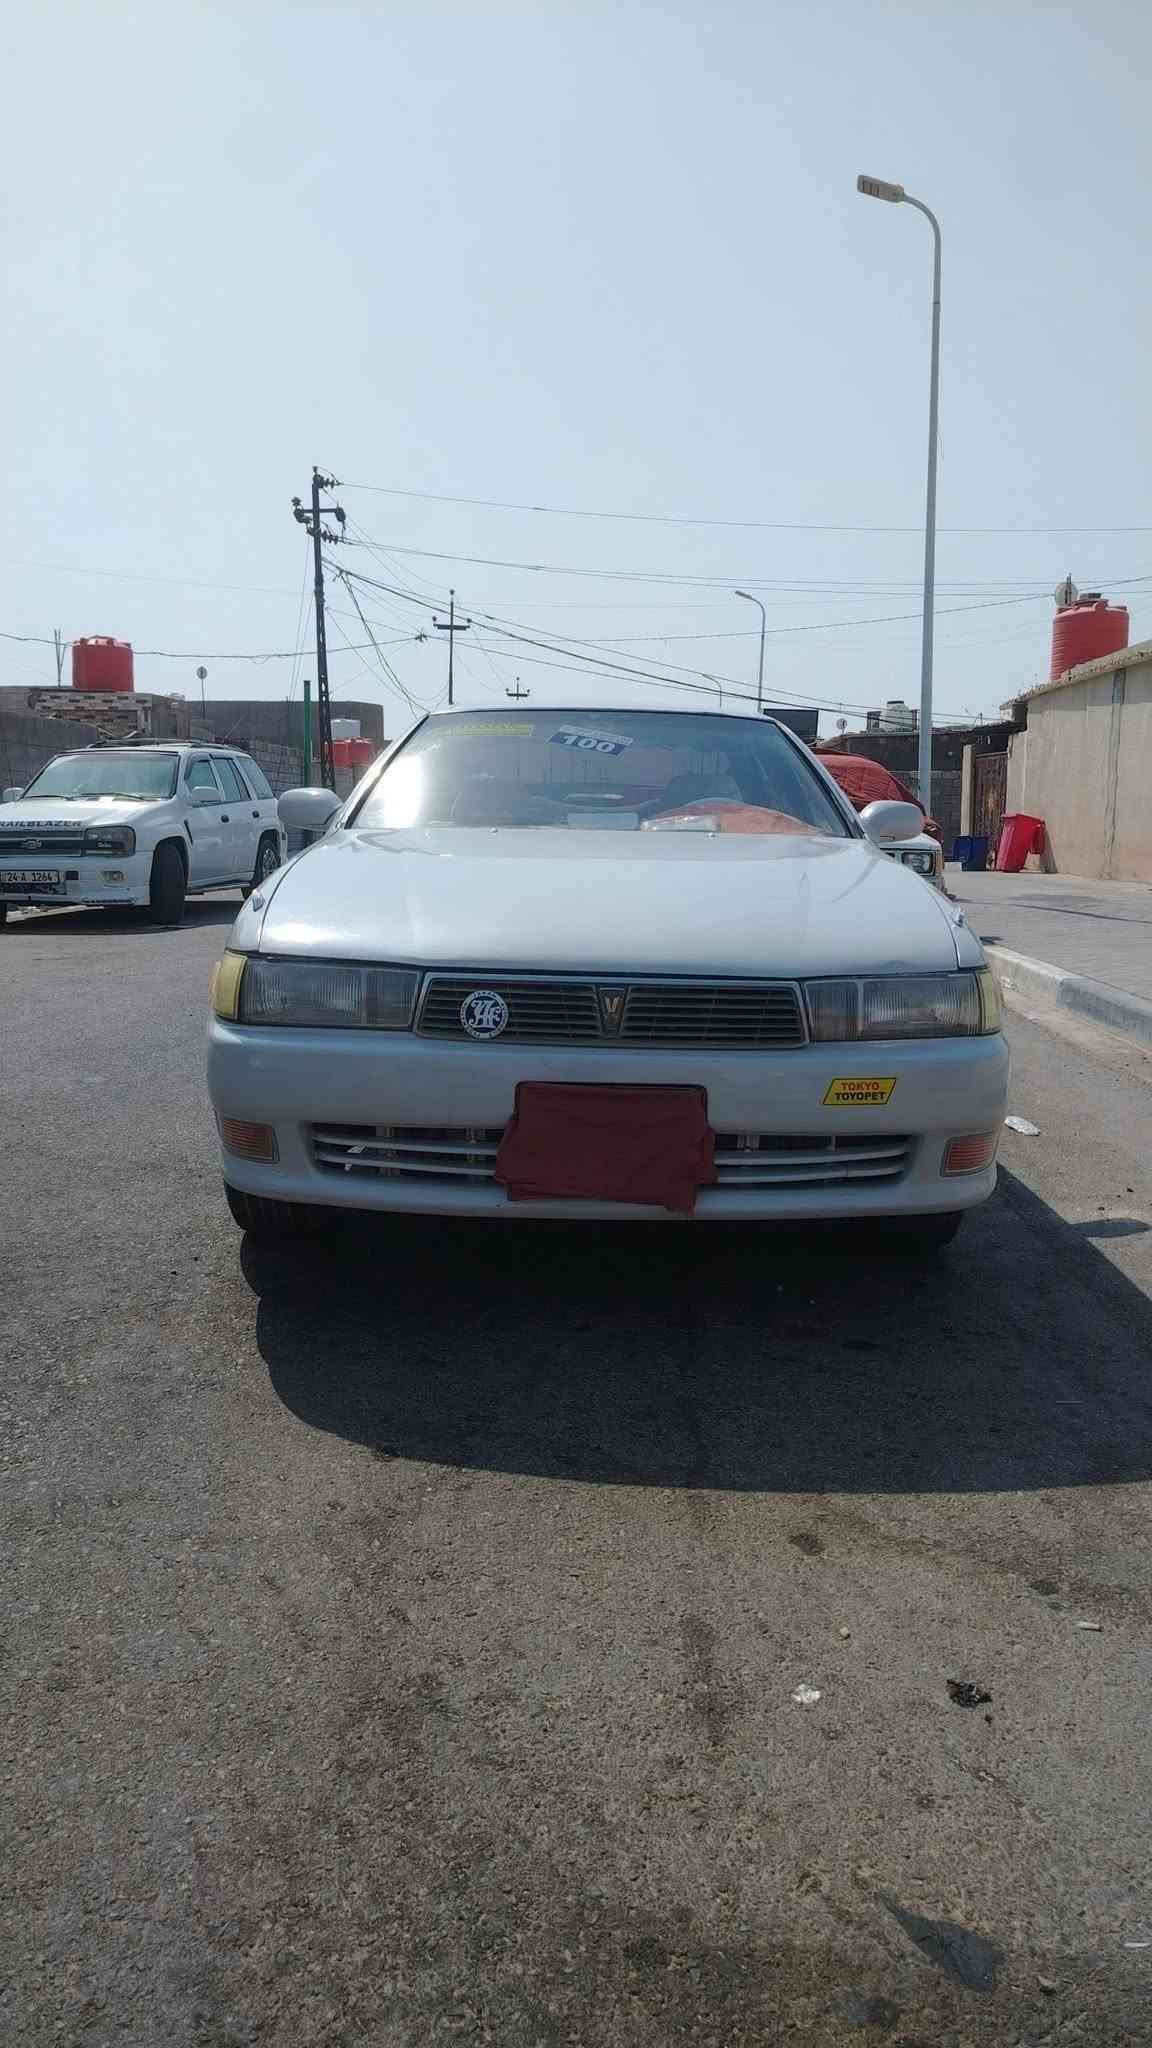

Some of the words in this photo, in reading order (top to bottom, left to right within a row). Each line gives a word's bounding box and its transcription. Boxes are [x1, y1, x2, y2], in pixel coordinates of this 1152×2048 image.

[563, 735, 616, 753] 100
[841, 1081, 880, 1091] TOKYO
[834, 1091, 886, 1100] TOYOPET
